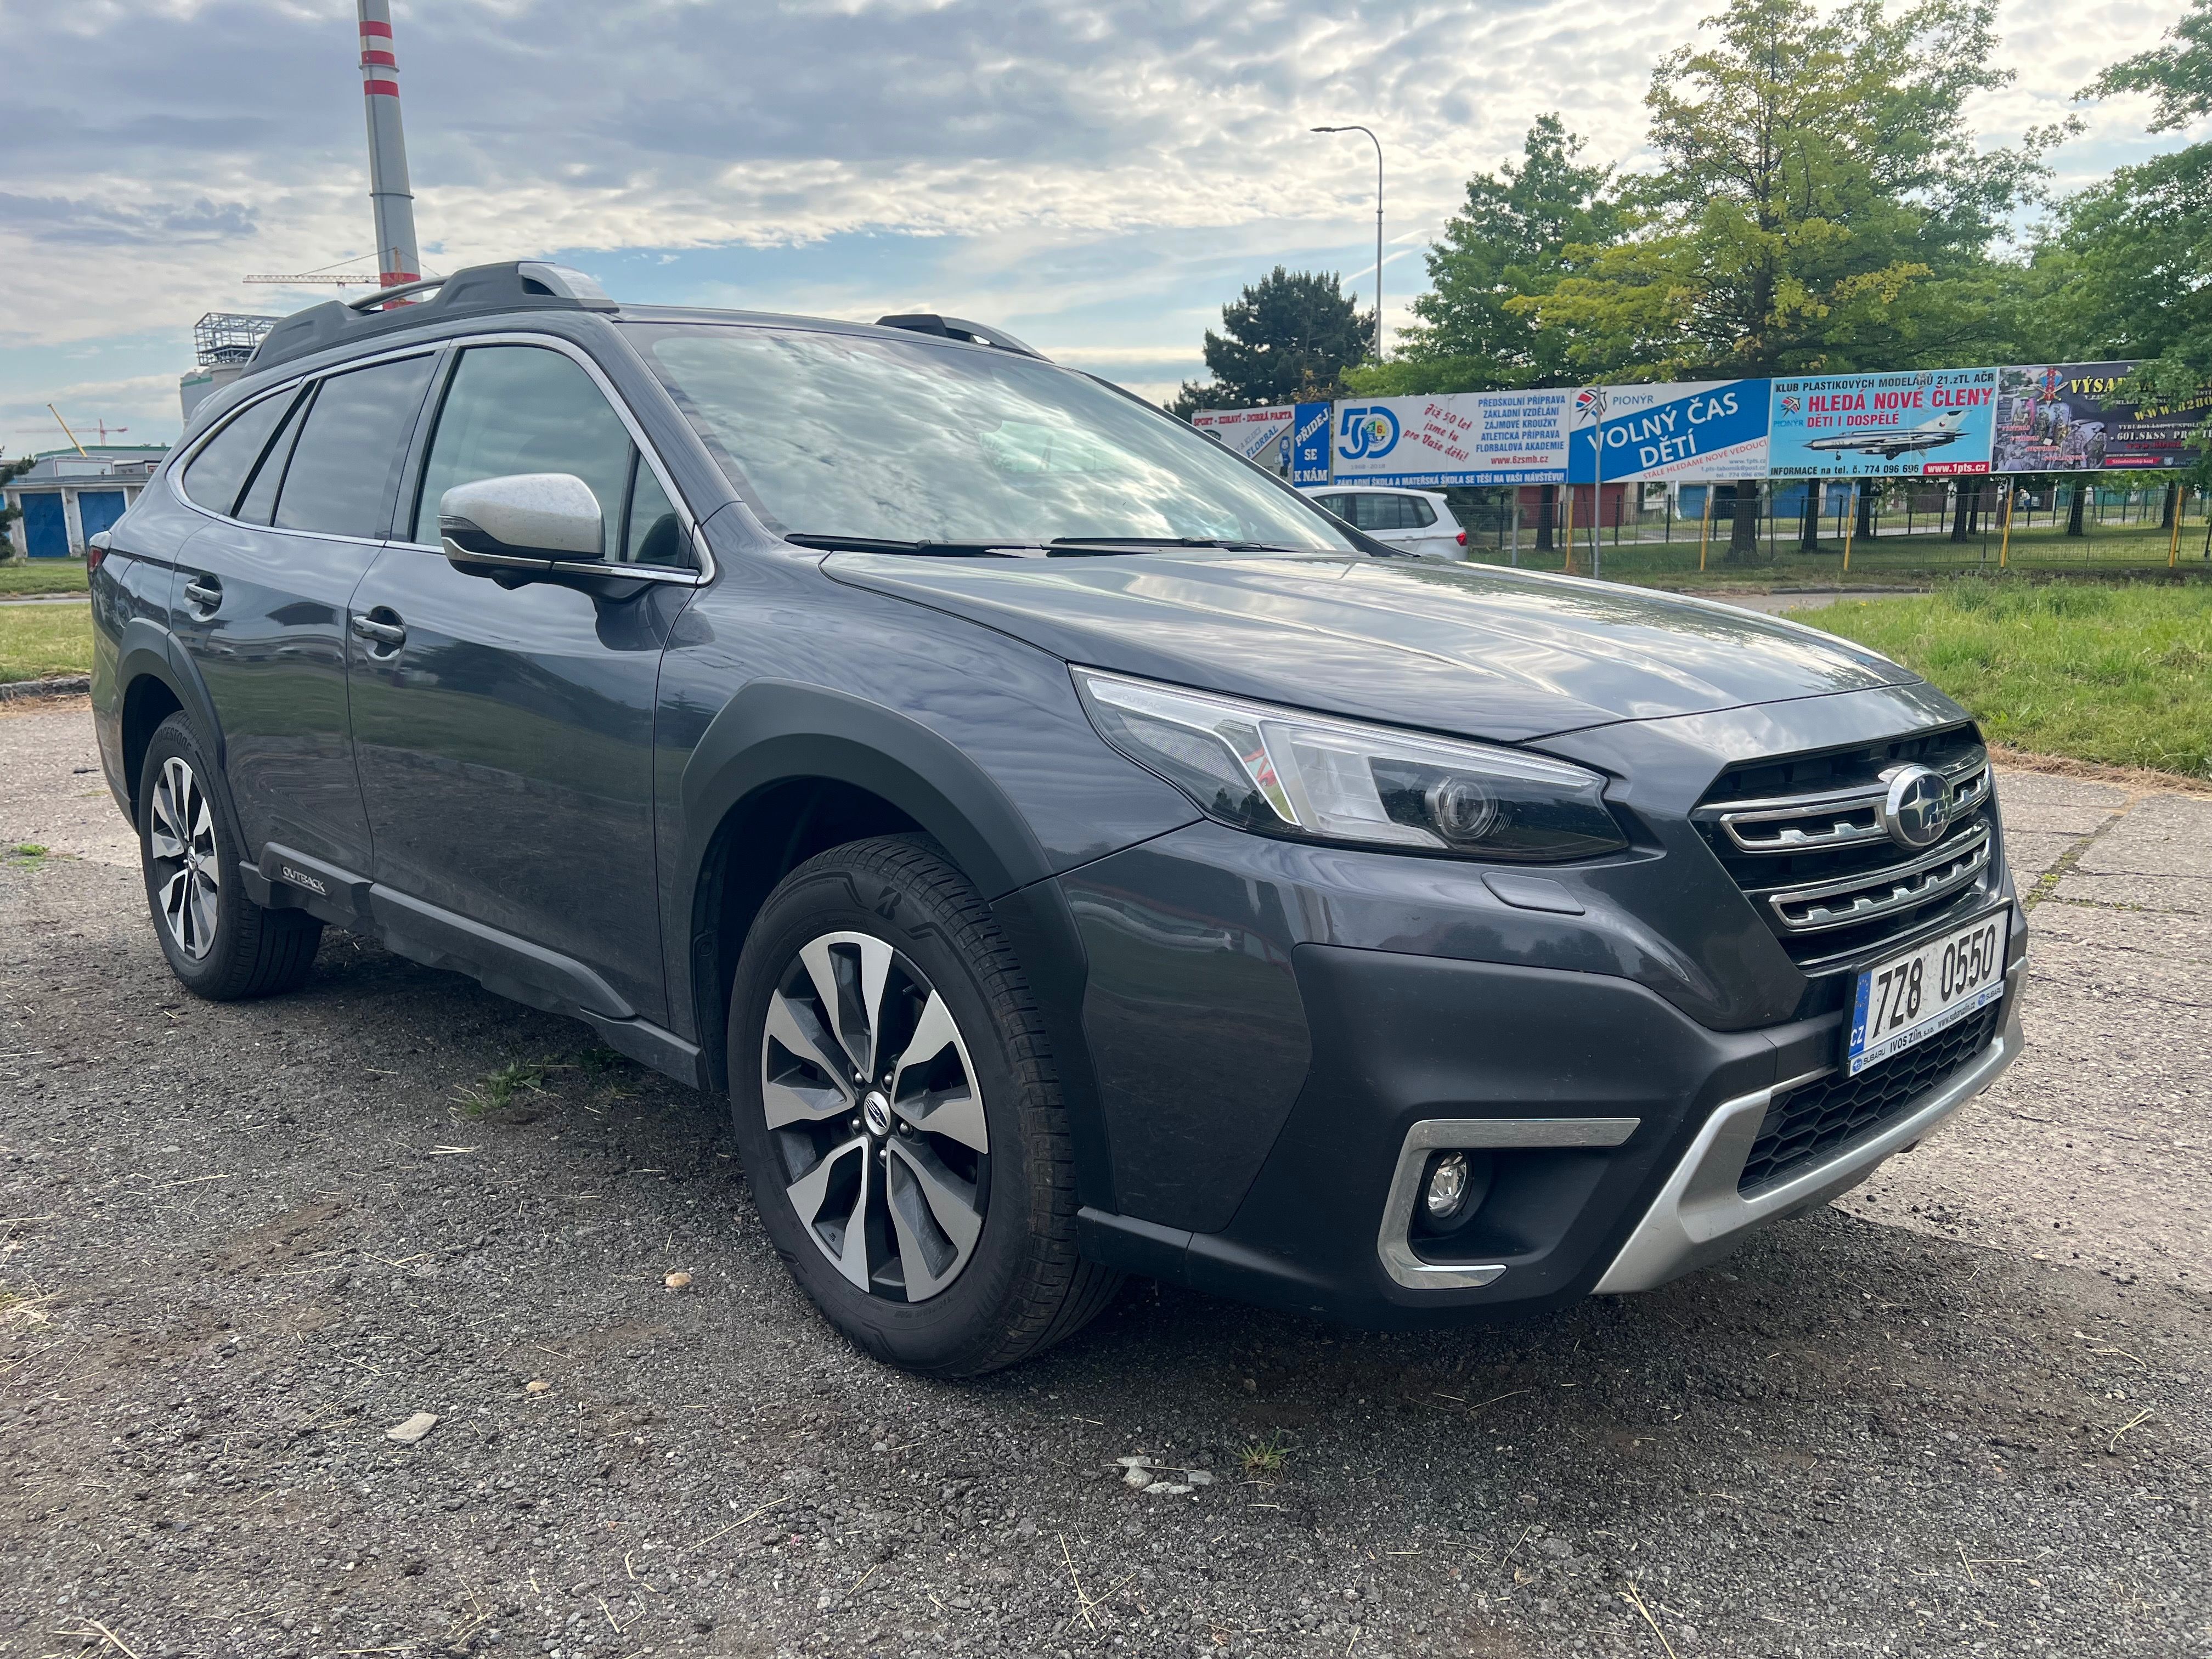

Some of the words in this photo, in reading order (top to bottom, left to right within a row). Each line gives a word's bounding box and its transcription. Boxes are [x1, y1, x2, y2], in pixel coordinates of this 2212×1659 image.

[1776, 383, 1799, 392] KLUB
[1803, 377, 1875, 391] PLASTIKOVÝCH
[1937, 375, 1970, 385] 21.zTL
[1974, 370, 1994, 382] AČR
[1478, 395, 1525, 407] PŘEDŠKOLNÍ
[1527, 394, 1565, 404] PŘÍPRAVA
[1613, 393, 1654, 405] PIONÝR
[1808, 389, 1865, 412] HLEDÁ
[1874, 387, 1923, 409] NOVÉ
[1932, 385, 1993, 407] ČLENY
[1194, 417, 1213, 426] SPORT
[1270, 410, 1293, 420] PARTA
[1443, 411, 1457, 424] 50
[1457, 417, 1473, 431] let
[1483, 407, 1520, 419] ZÁKLADNÍ
[1523, 405, 1559, 416] VZDĚLÁNÍ
[1774, 419, 1804, 427] PIONÝR
[1807, 414, 1832, 427] DĚTI
[1838, 416, 1842, 426] I
[1847, 410, 1899, 426] DOSPĚLÉ
[1295, 408, 1330, 447] PŘIDEJ
[1424, 420, 1446, 436] jsme
[1447, 430, 1459, 442] tu
[1485, 419, 1520, 430] ZÁJMOVÉ
[1522, 417, 1557, 428] KROUŽKY
[1587, 405, 1677, 453] VOLNÝ
[1687, 392, 1739, 424] ČAS
[1339, 406, 1400, 459] 50
[1481, 430, 1519, 441] ATLETICKÁ
[1522, 428, 1560, 439] PŘÍPRAVA
[1304, 448, 1318, 461] SE
[1403, 429, 1420, 440] pro
[1421, 434, 1444, 452] Vaše
[1445, 445, 1470, 462] děti!
[1476, 441, 1522, 453] FLORBALOVÁ
[1525, 441, 1564, 450] AKADEMIE
[1639, 428, 1697, 468] DĚTÍ
[1491, 455, 1549, 465] www.6zsmb.cz
[1643, 466, 1665, 479] STÁLE
[1667, 456, 1703, 473] HLEDÁME
[1705, 450, 1728, 462] NOVÉ
[1927, 464, 1986, 474] www.1pts.cz
[1294, 470, 1302, 482] K
[1302, 467, 1328, 482] NÁM
[1371, 476, 1394, 486] ŠKOLA
[1440, 474, 1464, 484] ŠKOLA
[1465, 476, 1475, 484] SE
[1476, 473, 1492, 483] TĚŠÍ
[1493, 475, 1504, 483] NA
[1505, 472, 1522, 482] VAŠI
[1524, 471, 1564, 482] NÁVŠTĚVU!
[1771, 467, 1818, 475] INFORMACE
[1835, 466, 1848, 474] tel.
[1865, 465, 1880, 473] 774
[1883, 465, 1899, 473] 096
[1903, 464, 1919, 473] 696
[282, 865, 325, 893] OUTBACK
[1872, 955, 1923, 1039] 7Z8
[1941, 924, 1996, 1002] 0550
[1863, 1048, 1886, 1065] SUBARU
[1889, 1035, 1908, 1053] IVOS
[1986, 987, 2002, 1000] SUBARU
[1850, 1025, 1865, 1048] CZ
